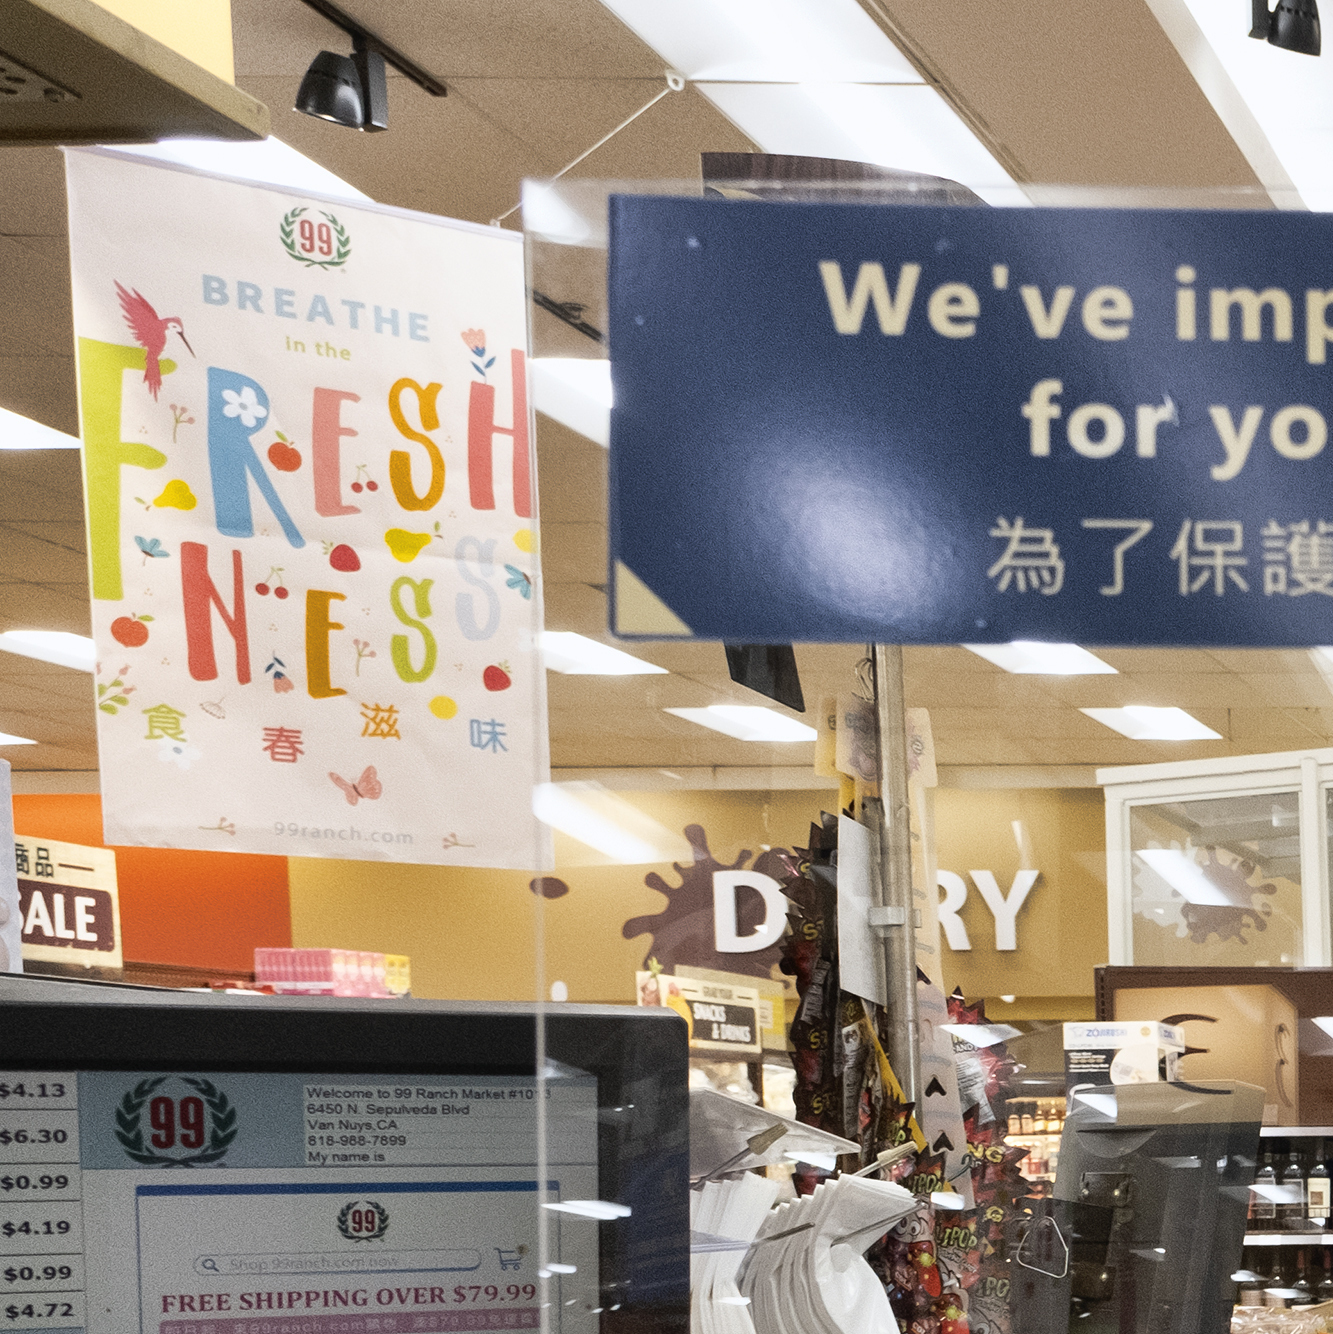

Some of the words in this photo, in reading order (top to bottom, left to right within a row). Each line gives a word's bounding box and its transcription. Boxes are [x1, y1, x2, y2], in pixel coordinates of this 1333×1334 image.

[299, 218, 333, 258] 99
[200, 274, 432, 344] BREATHE
[818, 259, 1134, 341] We've
[284, 335, 308, 354] in
[314, 339, 352, 361] the
[1021, 378, 1175, 459] for
[79, 337, 535, 602] FRESH
[274, 821, 415, 846] 99ranch.com
[18, 890, 98, 942] ALE
[712, 869, 1040, 954] DRY
[693, 1003, 727, 1022] SNACKS
[720, 1024, 752, 1042] DRINKS
[0, 1083, 66, 1099] $4.13
[306, 1087, 374, 1101] Welcome
[376, 1088, 391, 1101] to
[393, 1088, 413, 1101] 99
[415, 1088, 459, 1101] Ranch
[462, 1088, 506, 1101] Market
[307, 1103, 344, 1116] 6450
[366, 1103, 438, 1119] Sepulveda
[440, 1103, 471, 1116] Blvd
[150, 1096, 205, 1150] 99
[307, 1119, 335, 1131] Van
[0, 1128, 68, 1146] $6.30
[308, 1151, 329, 1164] My
[331, 1152, 371, 1163] name
[374, 1151, 385, 1162] is
[0, 1174, 70, 1192] $0.99
[2, 1220, 72, 1238] $4.19
[352, 1208, 376, 1234] 99
[4, 1265, 73, 1284] $0.99
[161, 1293, 232, 1314] FREE
[238, 1288, 370, 1312] SHIPPING
[375, 1285, 447, 1307] OVER
[452, 1282, 537, 1305] $79.99
[5, 1302, 75, 1320] $4.72
